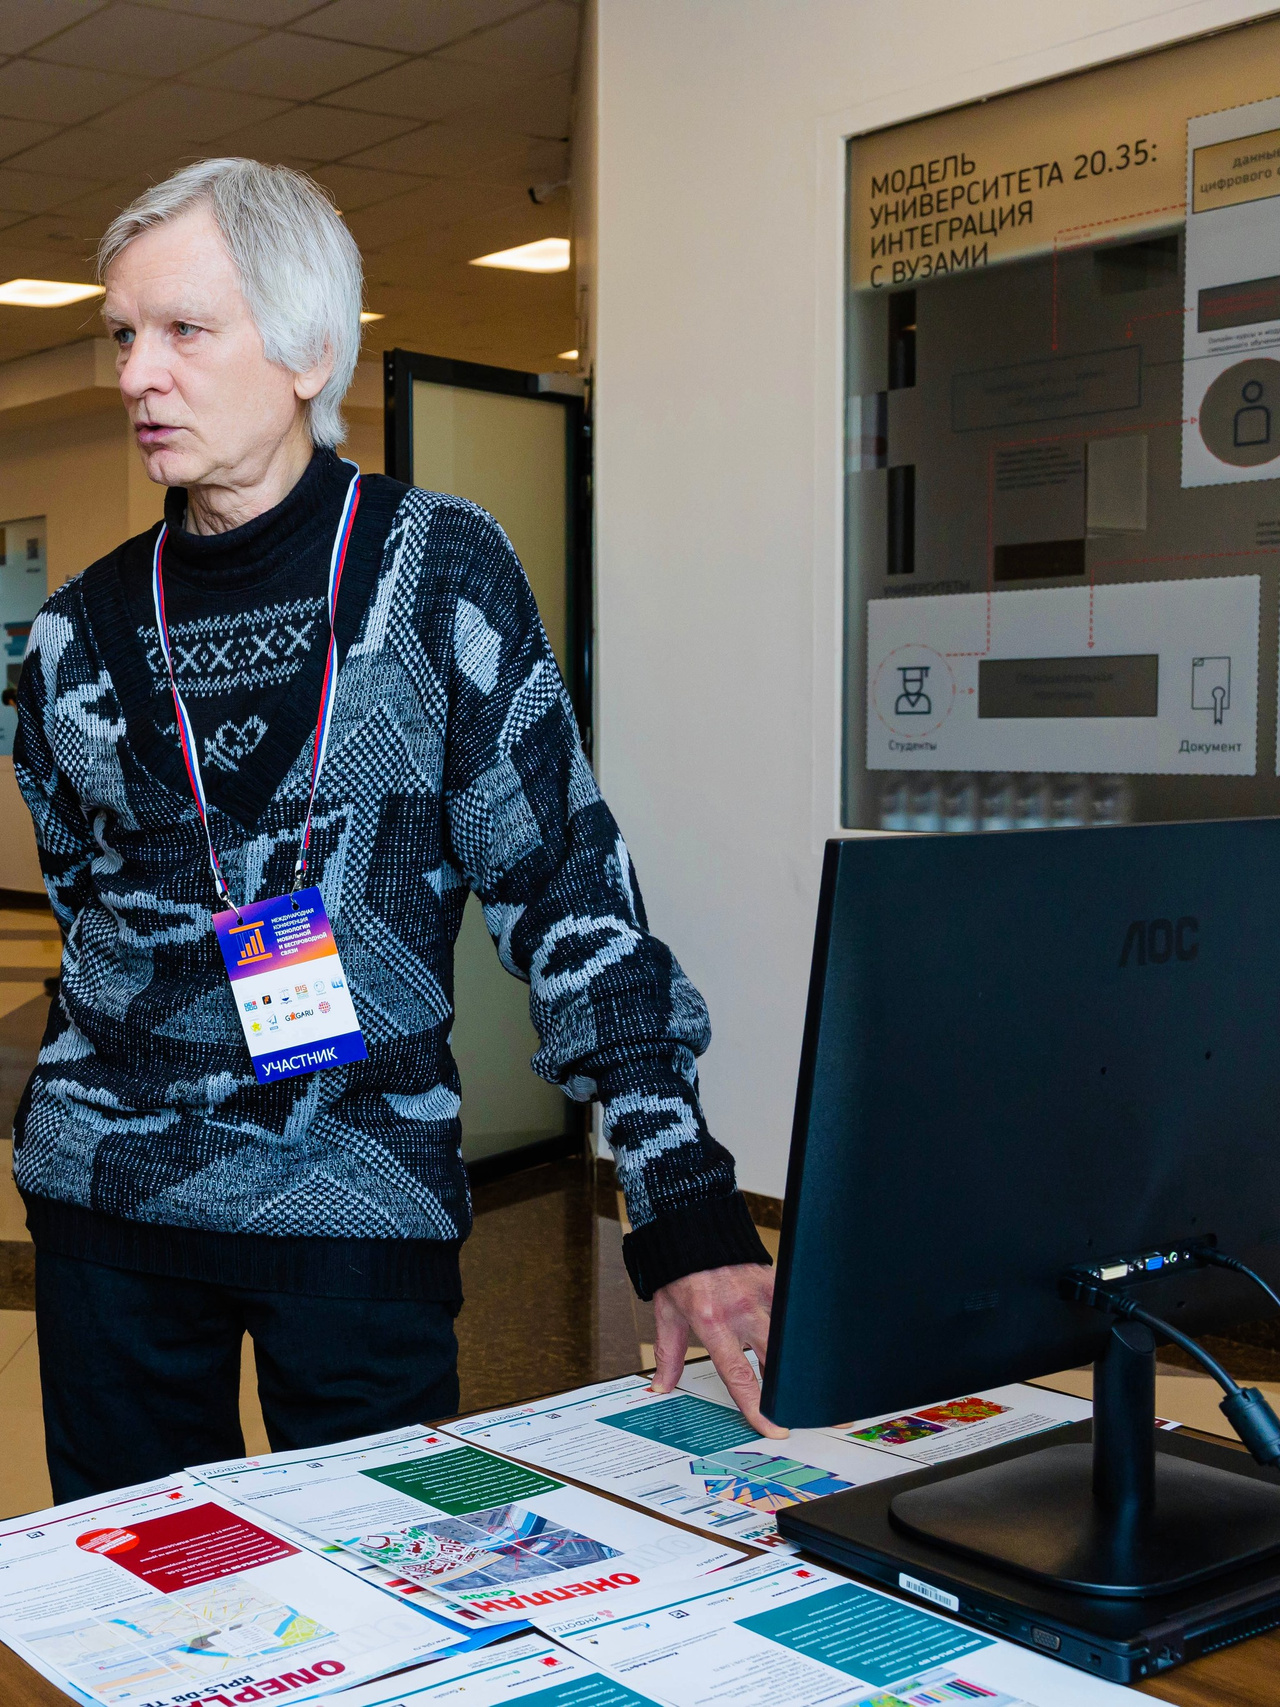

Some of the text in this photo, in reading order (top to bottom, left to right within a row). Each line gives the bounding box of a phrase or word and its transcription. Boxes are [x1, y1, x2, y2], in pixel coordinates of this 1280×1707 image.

[872, 153, 976, 198] МОДЕЛЬ
[1201, 169, 1272, 193] цифрового
[870, 140, 1157, 229] УНИВЕРСИТЕТА 20.35:
[872, 201, 1033, 258] ИНТЕГРАЦИЯ
[871, 243, 988, 288] С ВУЗАМИ
[888, 740, 937, 752] Студенты
[1179, 740, 1242, 753] Документ
[271, 908, 314, 923] МЕЖДУНАРОДНАЯ
[273, 917, 308, 930] КОНФЕРЕНЦИЯ
[275, 923, 310, 936] ТЕХНОЛОГИИ
[277, 929, 311, 943] МОБИЛЬНОЙ
[284, 932, 327, 948] БЕСПРОВОДНОЙ
[281, 948, 298, 956] СВЯЗИ
[262, 1047, 338, 1076] УЧАСТНИК
[461, 1590, 516, 1601] Сазон
[470, 1573, 640, 1612] ОНЕПЛАН
[550, 1616, 601, 1633] ИНФОТЕЛ
[171, 1675, 255, 1702] RPLS-DB
